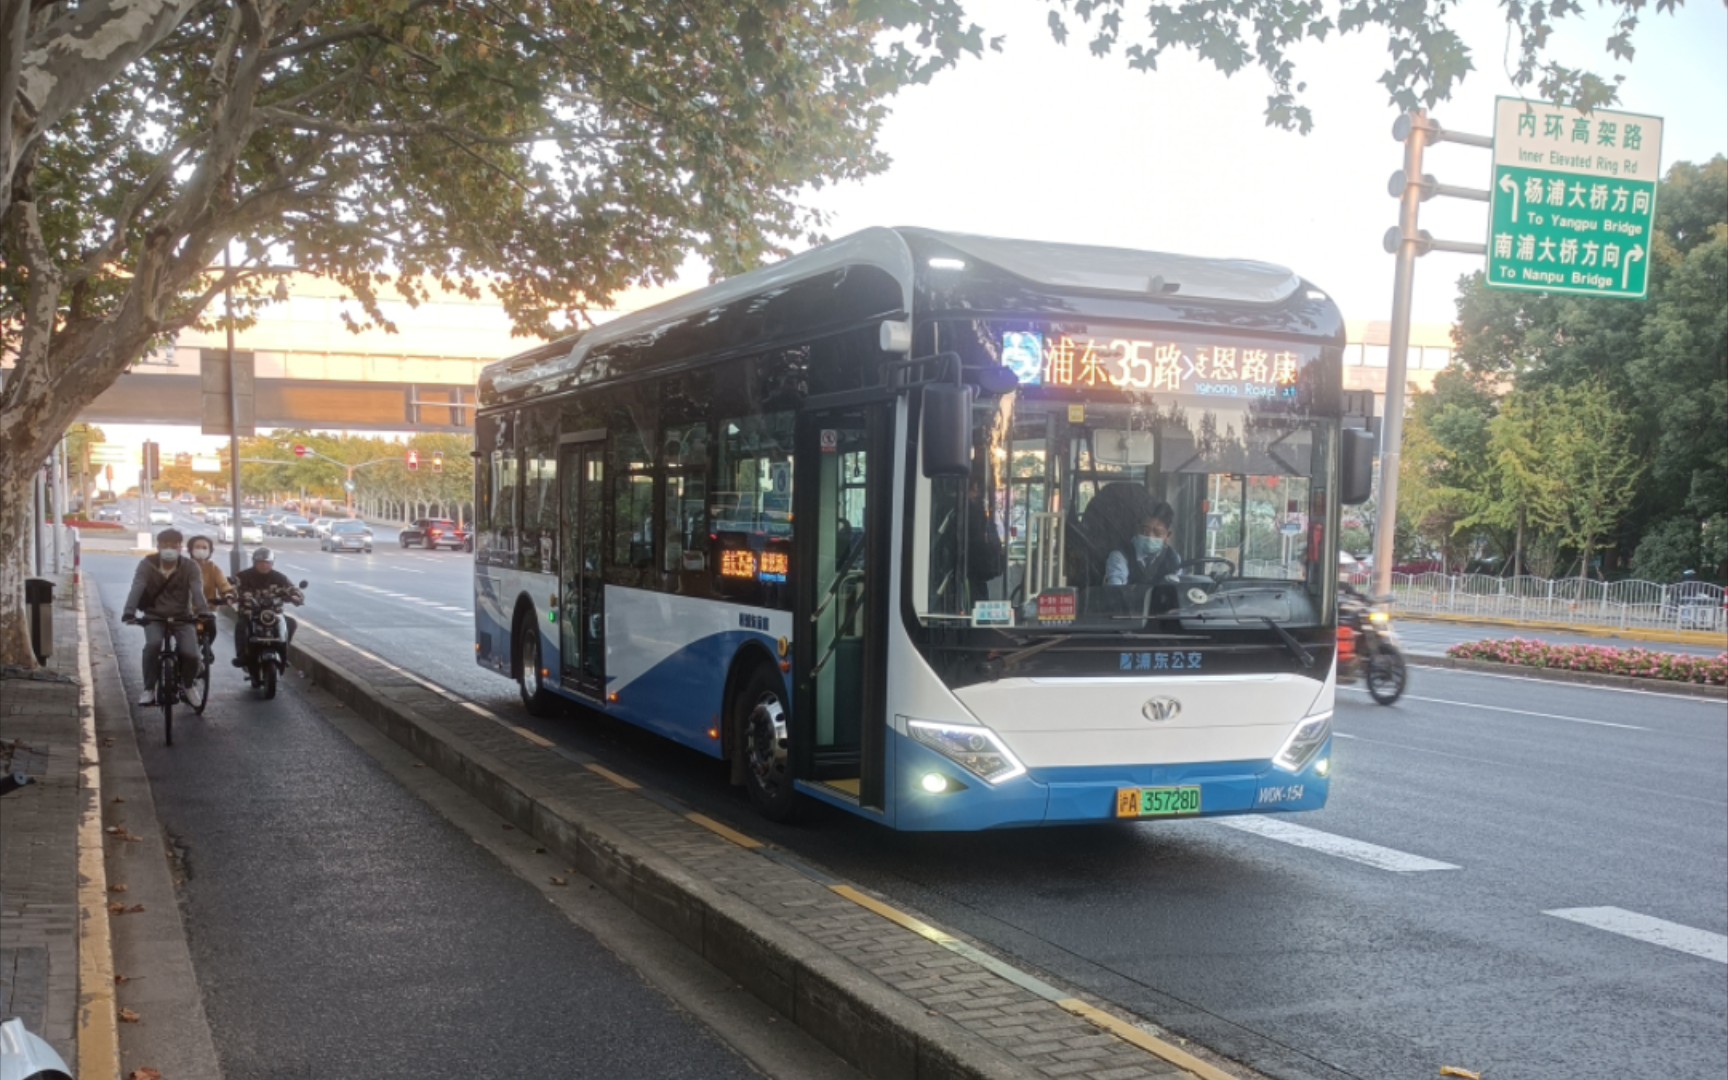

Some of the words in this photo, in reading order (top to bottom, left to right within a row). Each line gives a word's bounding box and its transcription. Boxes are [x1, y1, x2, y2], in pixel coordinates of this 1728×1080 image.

[1517, 113, 1642, 151] 内环高架路
[1519, 148, 1543, 164] Inner
[1550, 151, 1591, 169] Elevated
[1597, 156, 1618, 175] Ring
[1624, 159, 1638, 174] Rd
[1524, 176, 1650, 215] 杨浦大桥方向
[1528, 212, 1543, 225] To
[1552, 214, 1597, 231] Yangpu
[1604, 219, 1642, 236] Bridge
[1494, 232, 1620, 268] 南浦大桥方向
[1500, 266, 1516, 278] To
[1523, 268, 1564, 284] Nanpu
[1571, 272, 1613, 288] Bridge
[1245, 383, 1276, 397] Road
[1136, 651, 1202, 669] 浦东公交
